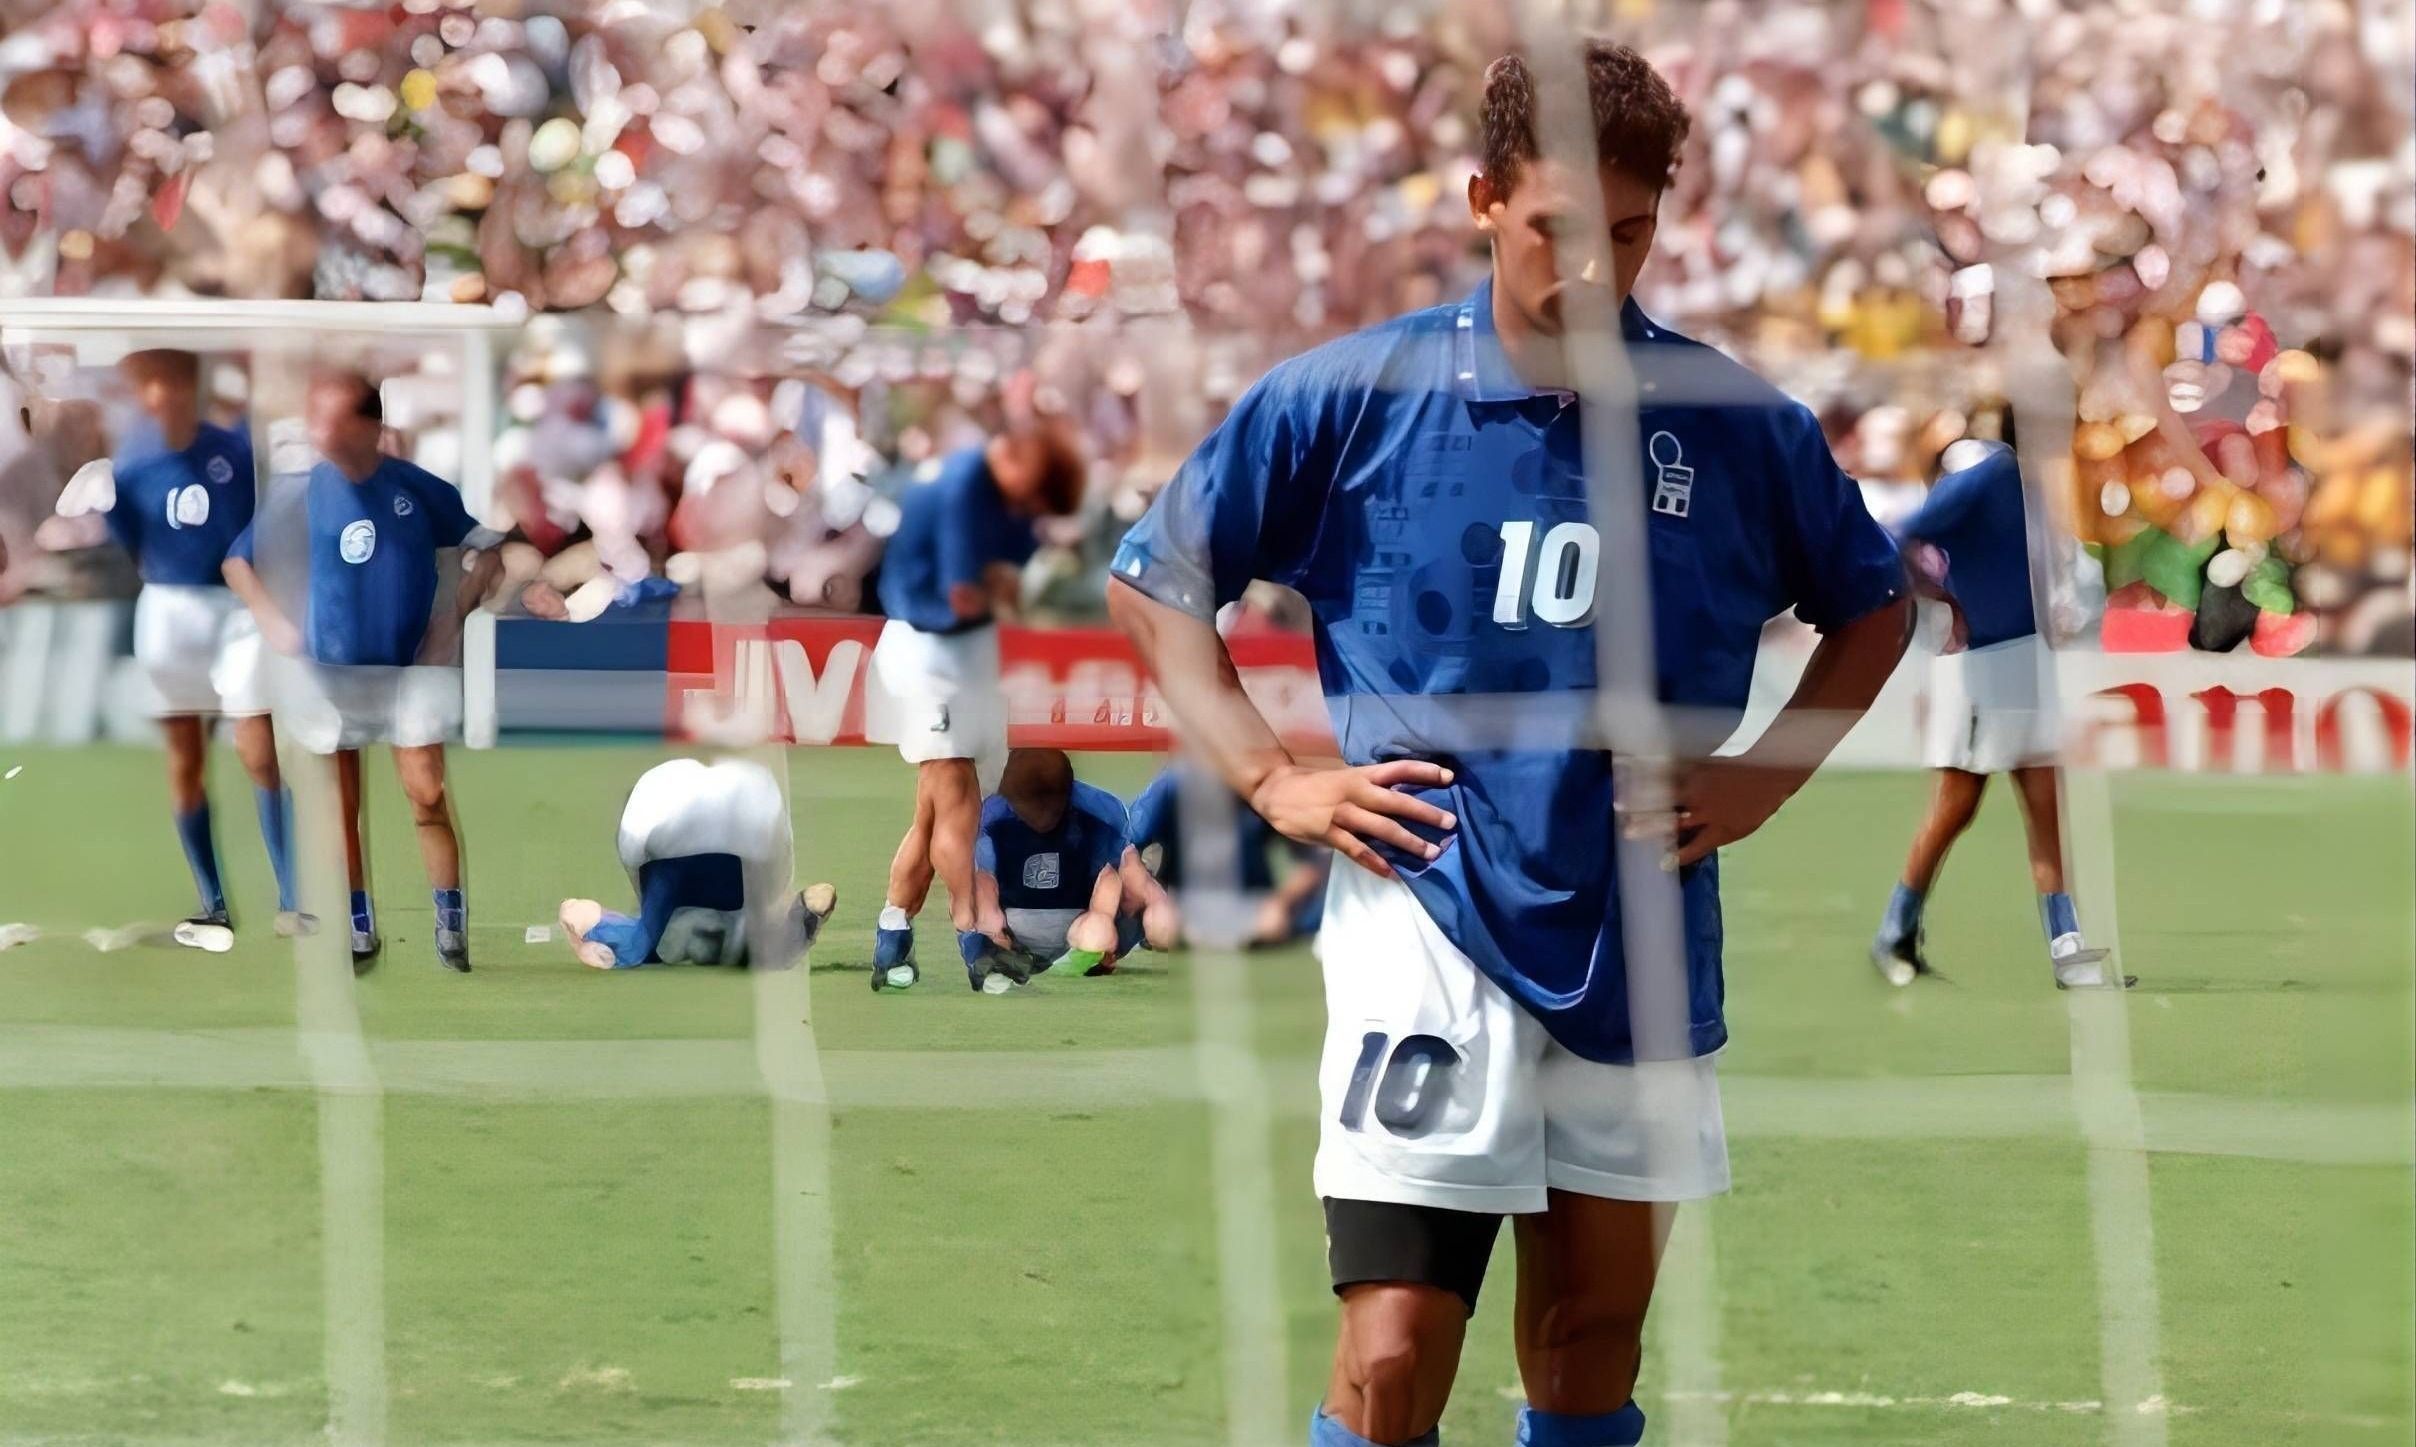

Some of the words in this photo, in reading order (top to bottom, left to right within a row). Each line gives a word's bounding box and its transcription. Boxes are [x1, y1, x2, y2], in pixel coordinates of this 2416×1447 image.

[1493, 521, 1600, 628] 10
[683, 639, 900, 746] JV
[1340, 1031, 1462, 1140] 10
